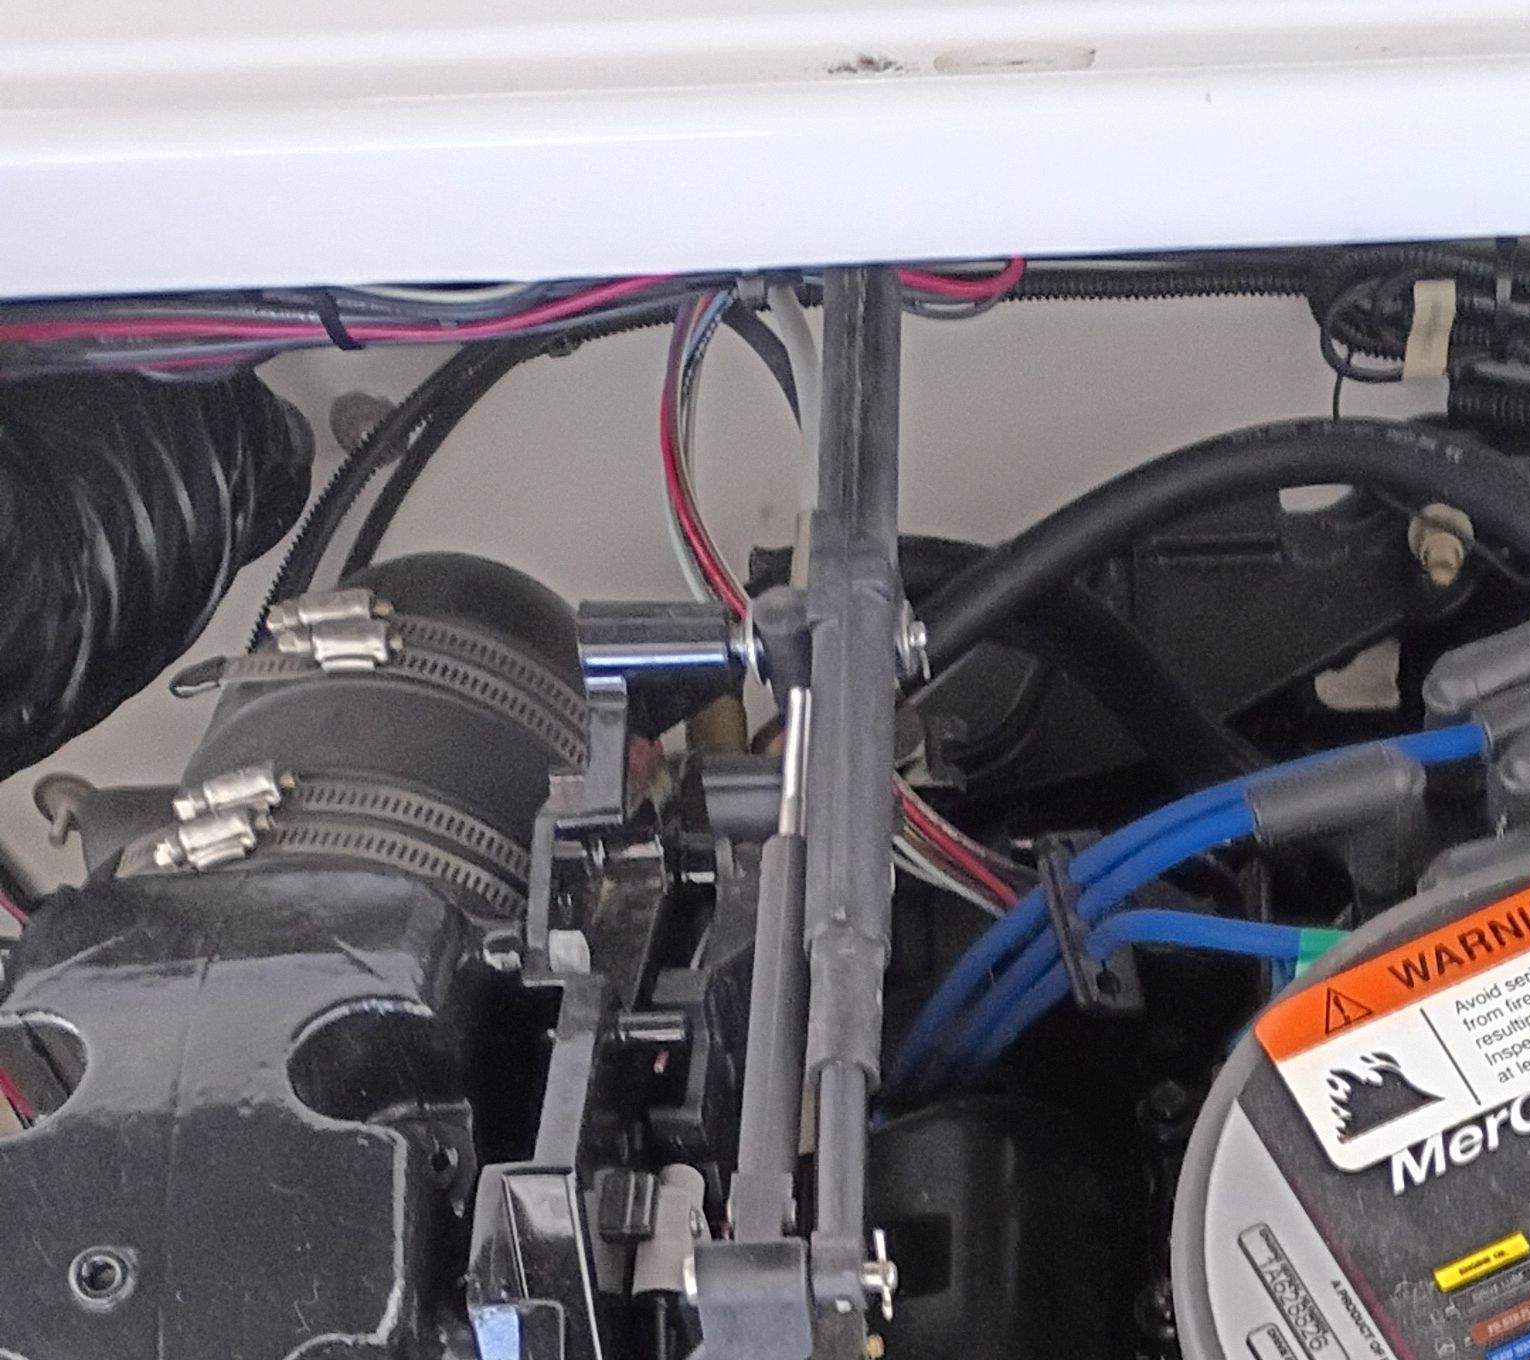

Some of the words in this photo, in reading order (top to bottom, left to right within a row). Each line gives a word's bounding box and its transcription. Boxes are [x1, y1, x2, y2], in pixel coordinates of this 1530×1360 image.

[1451, 982, 1502, 1016] Avoid
[1462, 1004, 1504, 1033] from
[1495, 1066, 1516, 1084] at
[1329, 1277, 1342, 1289] A
[1257, 1260, 1329, 1352] 1A628826
[1335, 1288, 1375, 1342] PRODUCT
[1264, 1327, 1288, 1357] DRIVE
[1367, 1338, 1385, 1358] OF
